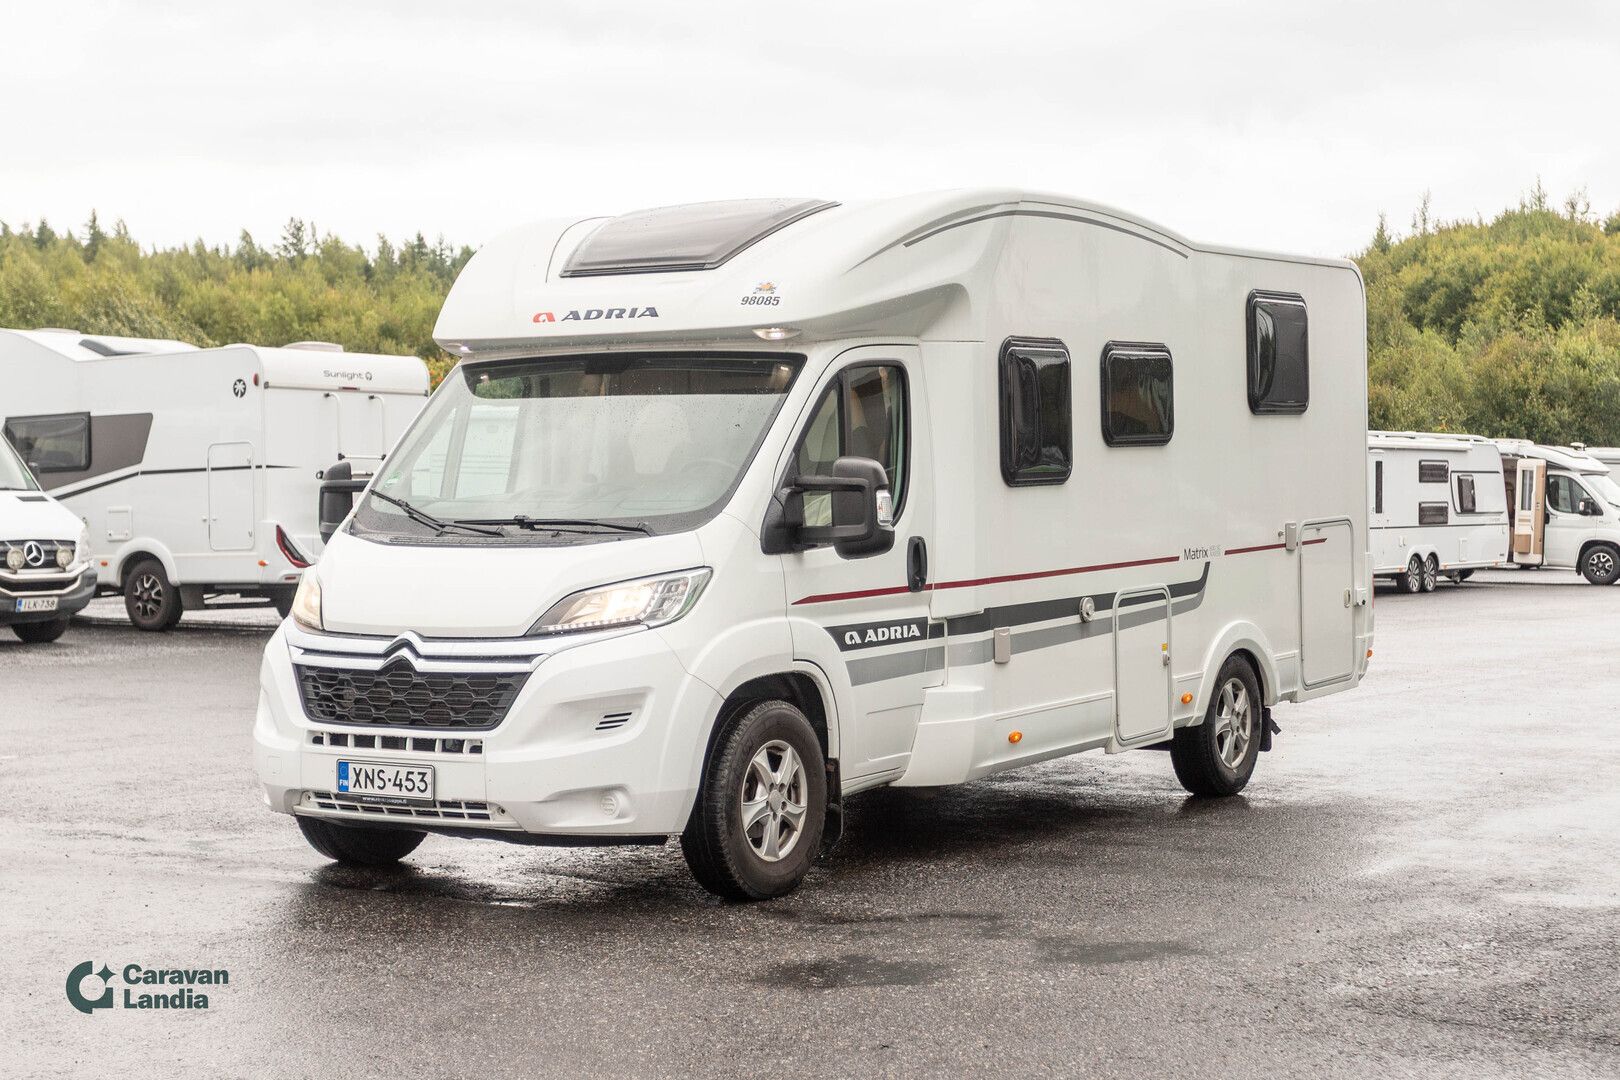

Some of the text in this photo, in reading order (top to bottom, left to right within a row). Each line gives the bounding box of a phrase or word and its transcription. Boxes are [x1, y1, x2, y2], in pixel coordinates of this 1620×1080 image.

[740, 296, 780, 306] 98085
[561, 306, 659, 322] ADRIA
[323, 369, 364, 381] Sunlight
[1183, 547, 1209, 561] Matrix
[864, 624, 921, 643] ADRIA
[352, 767, 428, 793] XNS-453
